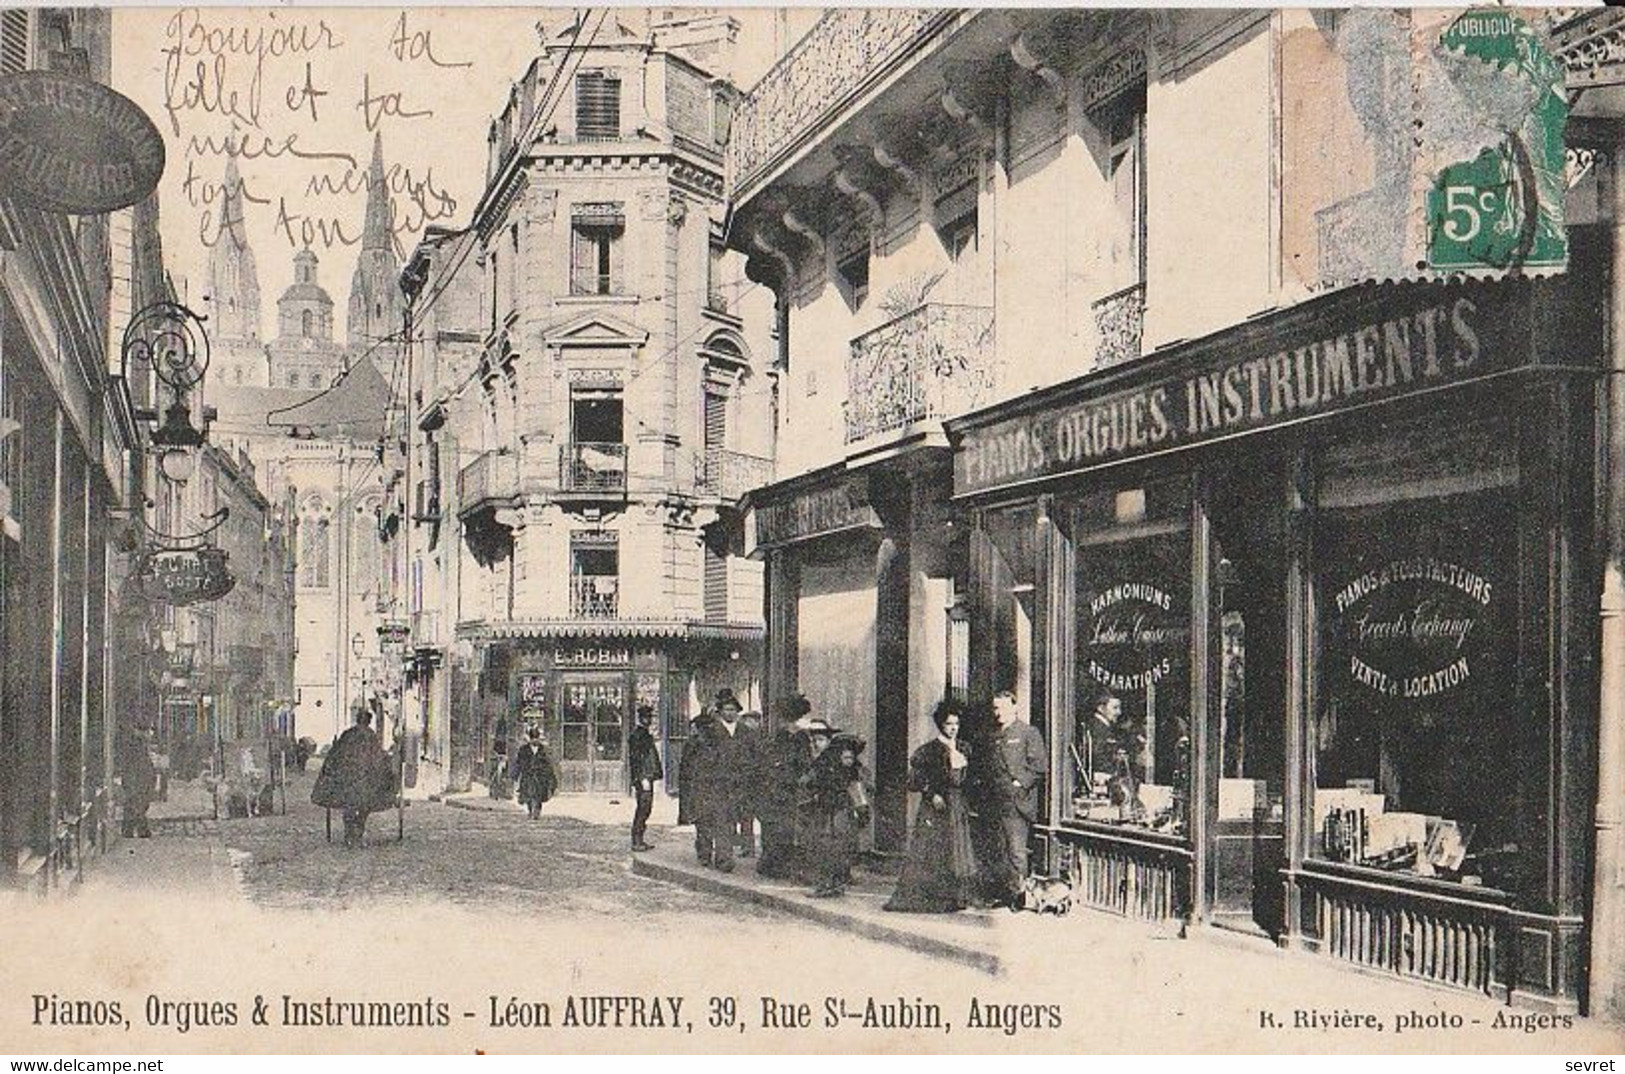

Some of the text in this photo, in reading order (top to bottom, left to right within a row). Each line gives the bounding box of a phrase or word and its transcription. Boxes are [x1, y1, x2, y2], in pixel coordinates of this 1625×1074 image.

[286, 62, 328, 121] et
[201, 209, 249, 252] et
[1186, 297, 1480, 434] INSTRUMENTS
[1090, 583, 1172, 616] HARMONIUMS
[1335, 570, 1378, 613] PIANOS
[575, 648, 629, 664] ROBIN
[1350, 655, 1387, 692] VENTE
[1403, 655, 1470, 697] LOCATION
[31, 994, 131, 1031] Pianos,
[145, 995, 239, 1033] Orgues
[252, 995, 269, 1026] &
[281, 994, 451, 1027] Instruments
[489, 995, 551, 1028] Léon
[563, 996, 693, 1033] AUFFRAY,
[708, 996, 746, 1033] 39,
[761, 997, 812, 1028] Rue
[966, 996, 1063, 1036] Angers
[1259, 1010, 1283, 1028] R.
[1294, 1008, 1384, 1032] Rivière,
[1395, 1009, 1464, 1033] photo
[1491, 1010, 1574, 1033] Angers
